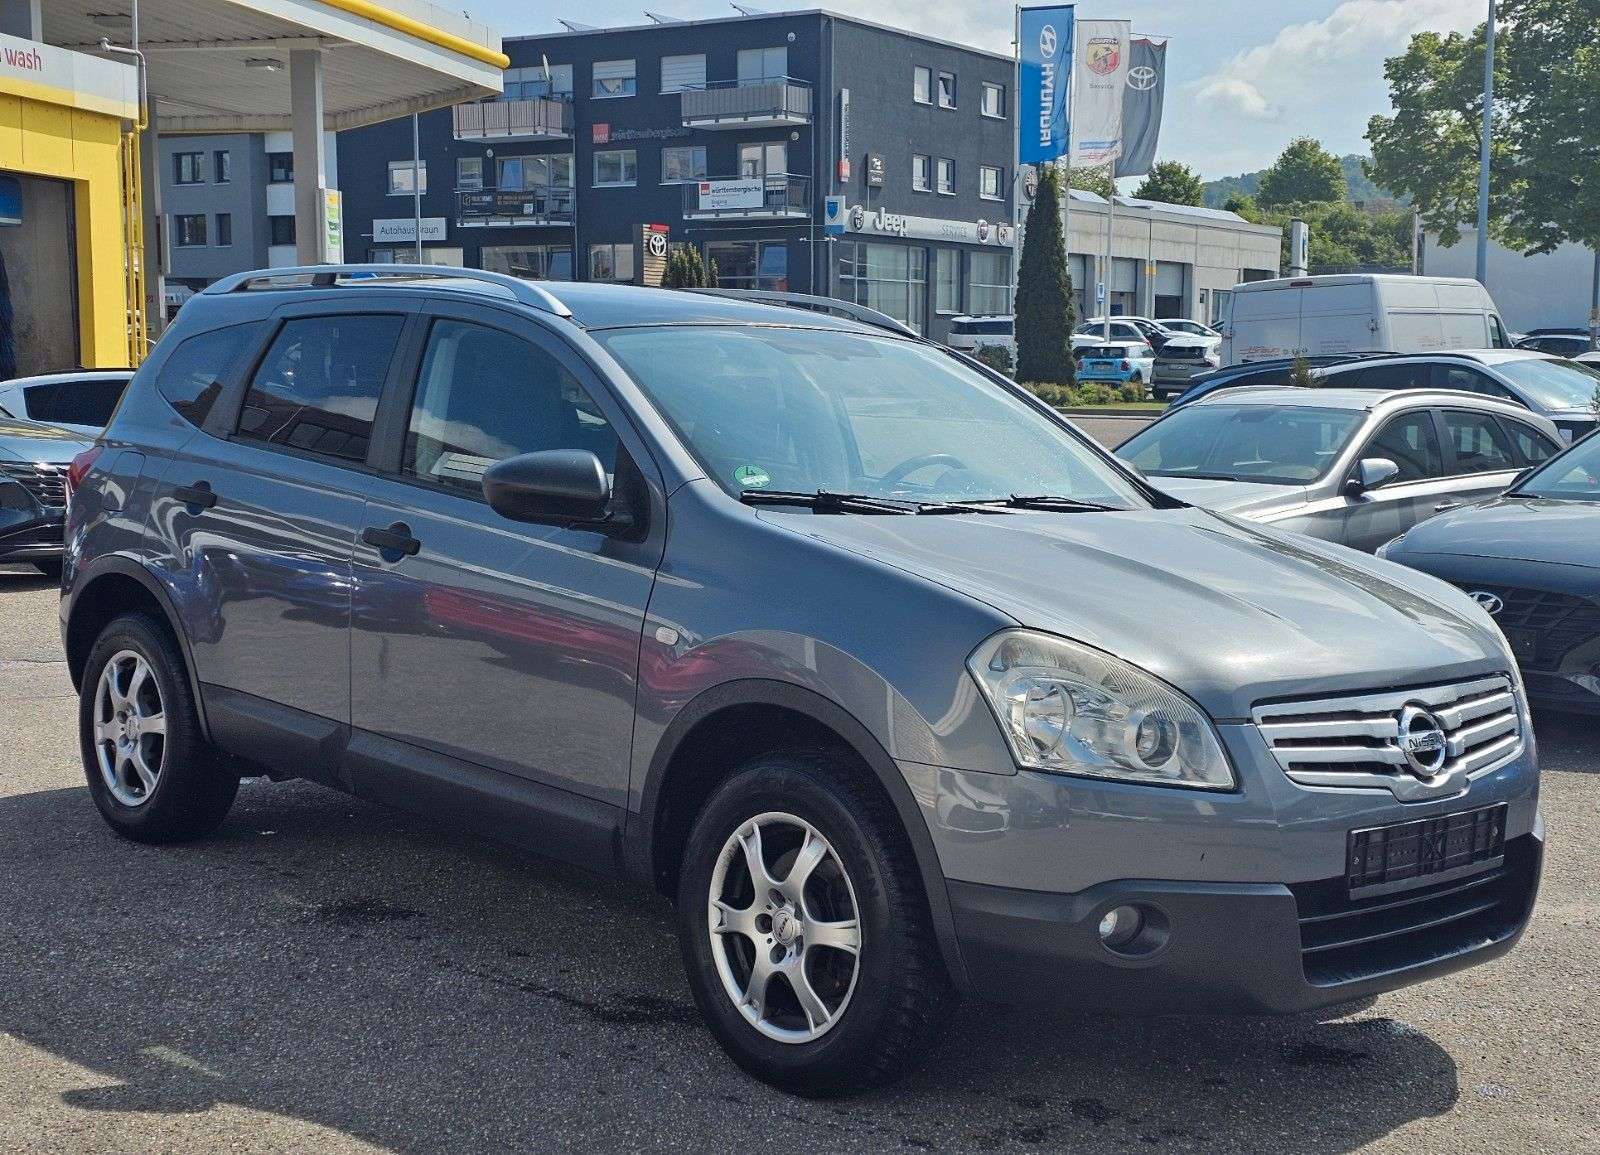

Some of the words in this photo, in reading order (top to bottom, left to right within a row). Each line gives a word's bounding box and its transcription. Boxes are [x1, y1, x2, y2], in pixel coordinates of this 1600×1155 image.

[4, 47, 42, 71] wash
[1039, 63, 1055, 147] HYUNDAI
[418, 226, 440, 234] raun
[875, 206, 907, 237] Jeep
